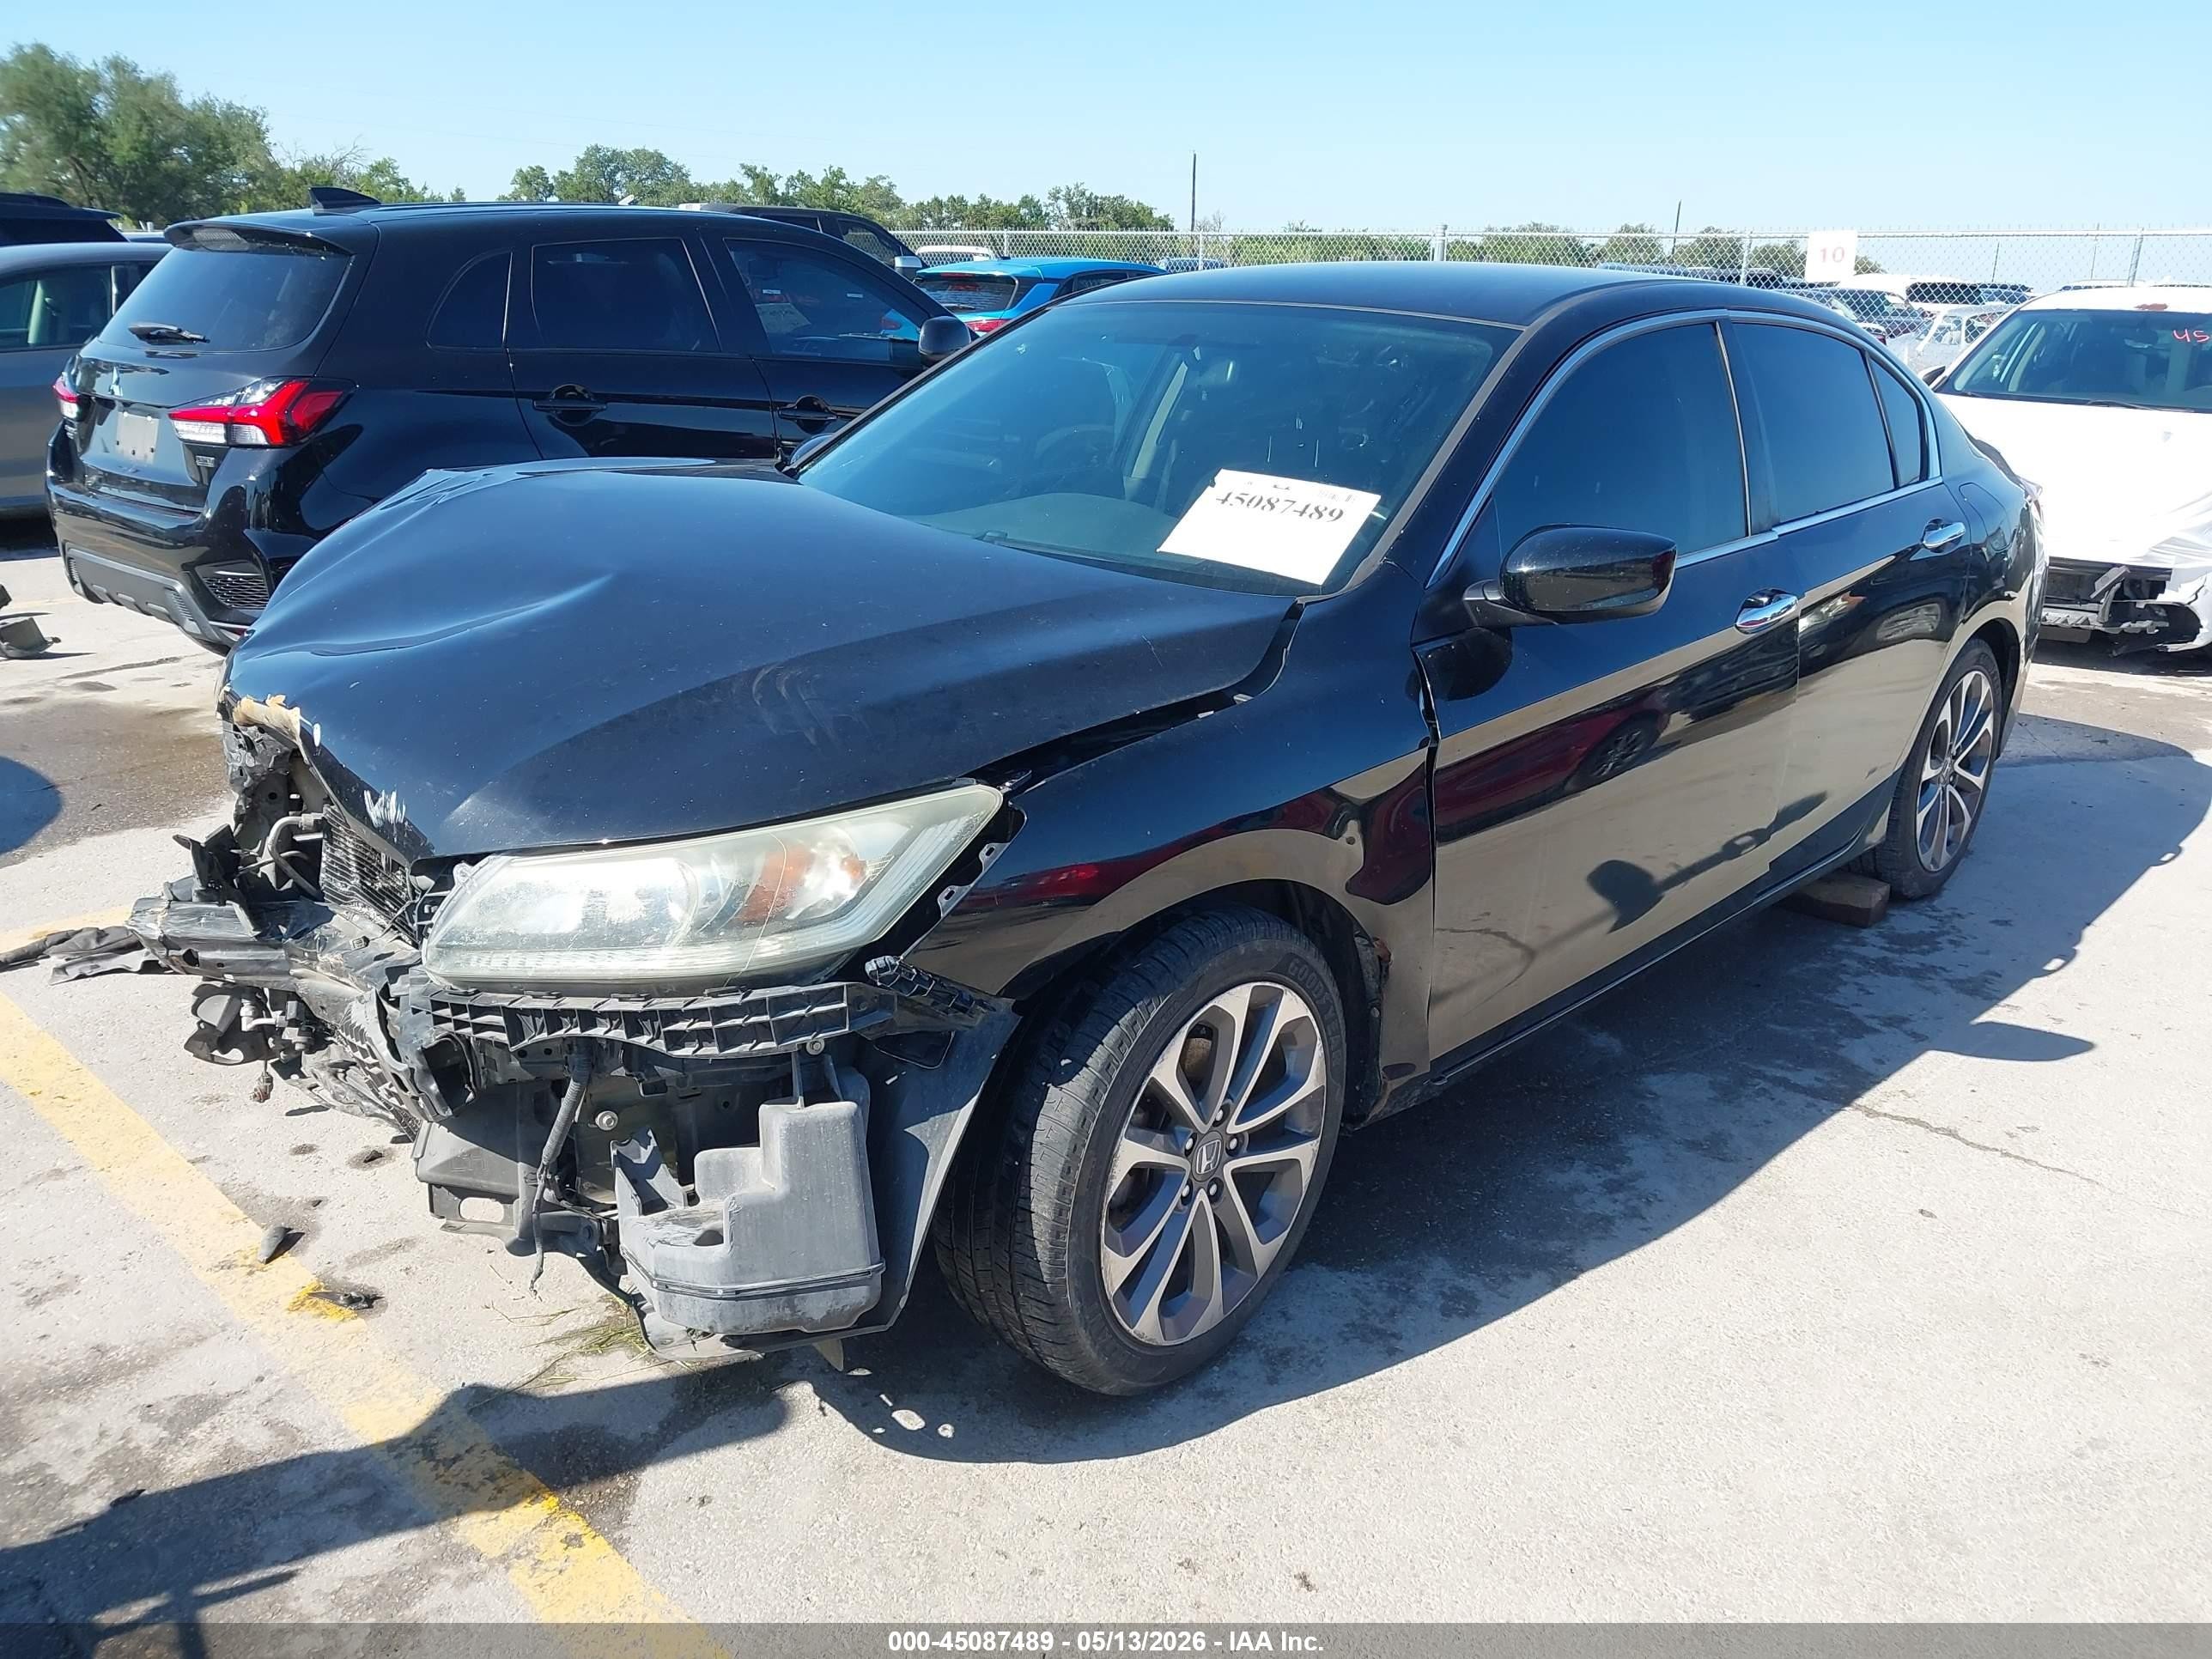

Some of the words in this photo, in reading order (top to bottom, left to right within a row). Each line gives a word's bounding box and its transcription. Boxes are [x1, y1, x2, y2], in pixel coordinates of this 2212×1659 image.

[1820, 246, 1845, 264] 10
[1216, 491, 1344, 522] 45087489
[1289, 957, 1343, 1066] GOODYEAR
